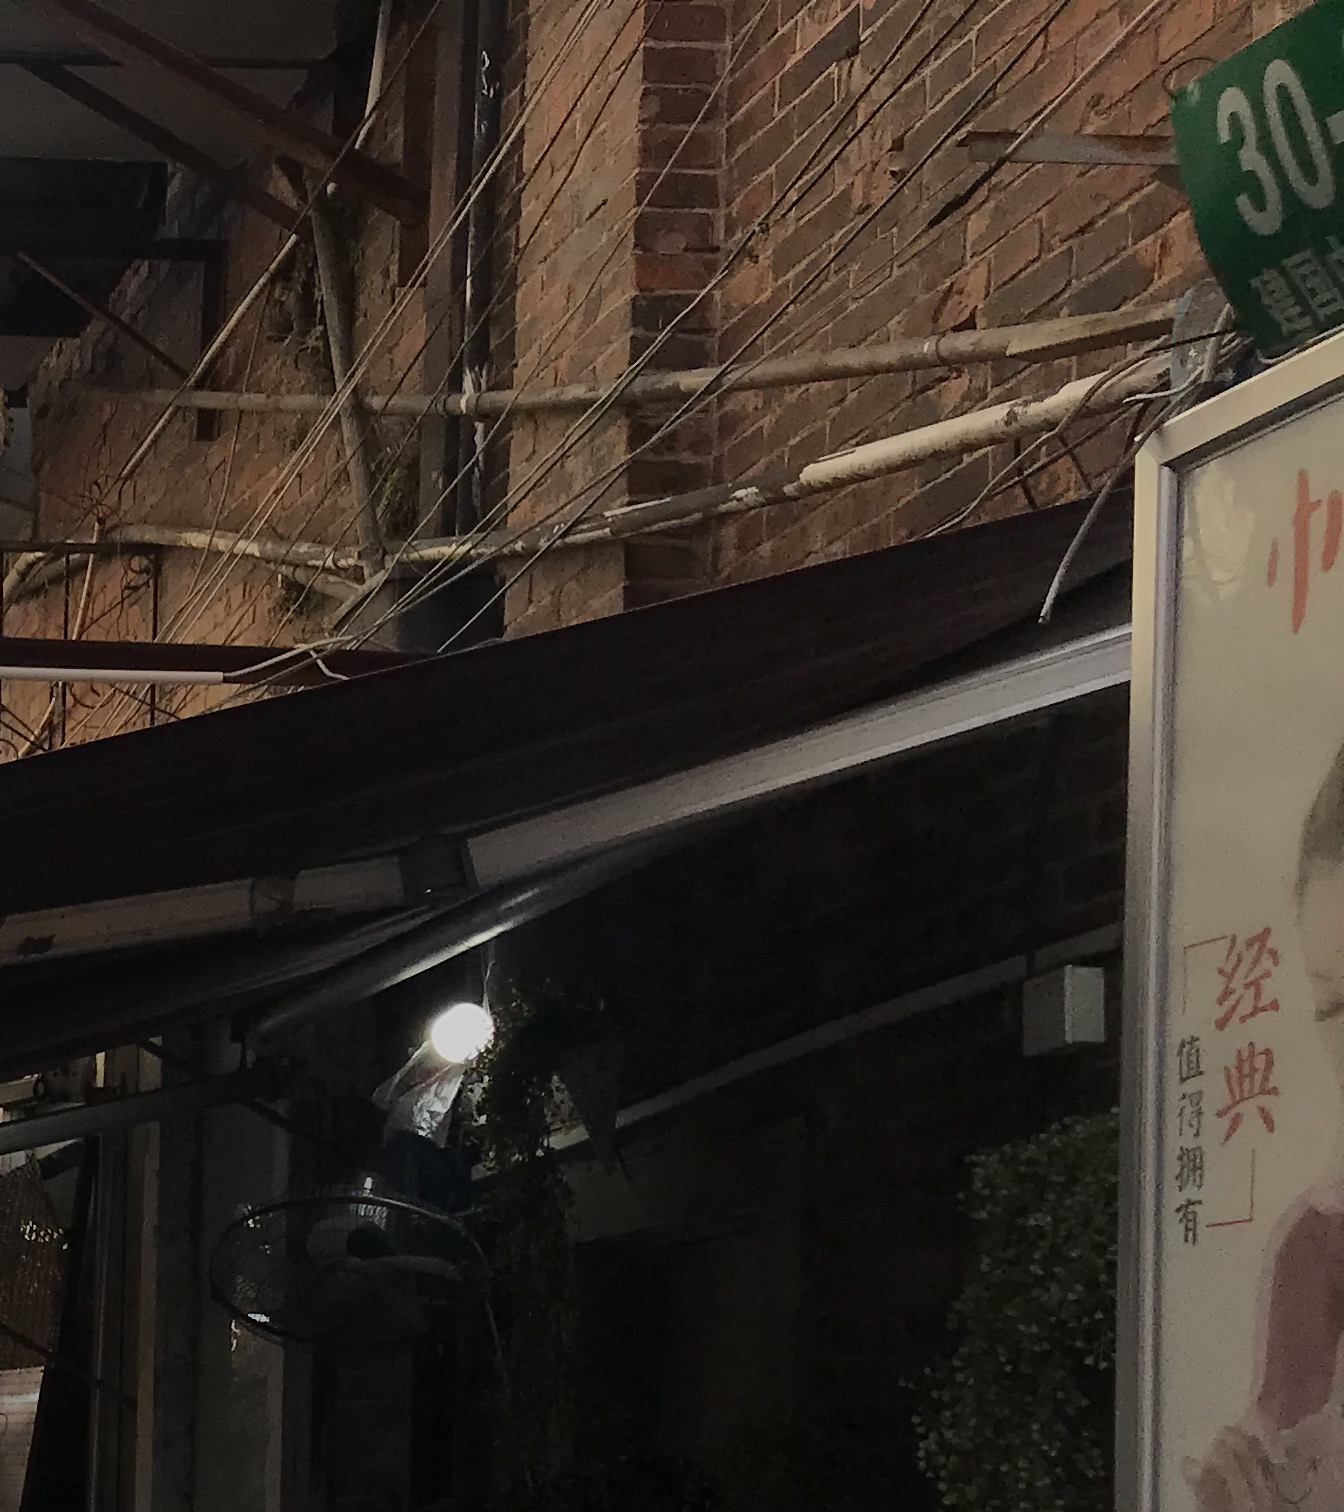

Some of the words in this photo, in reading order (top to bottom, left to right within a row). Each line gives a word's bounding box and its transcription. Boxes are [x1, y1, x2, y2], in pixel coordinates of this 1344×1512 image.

[1175, 1035, 1205, 1246] 值得拥有
[1215, 927, 1280, 1147] 经典
